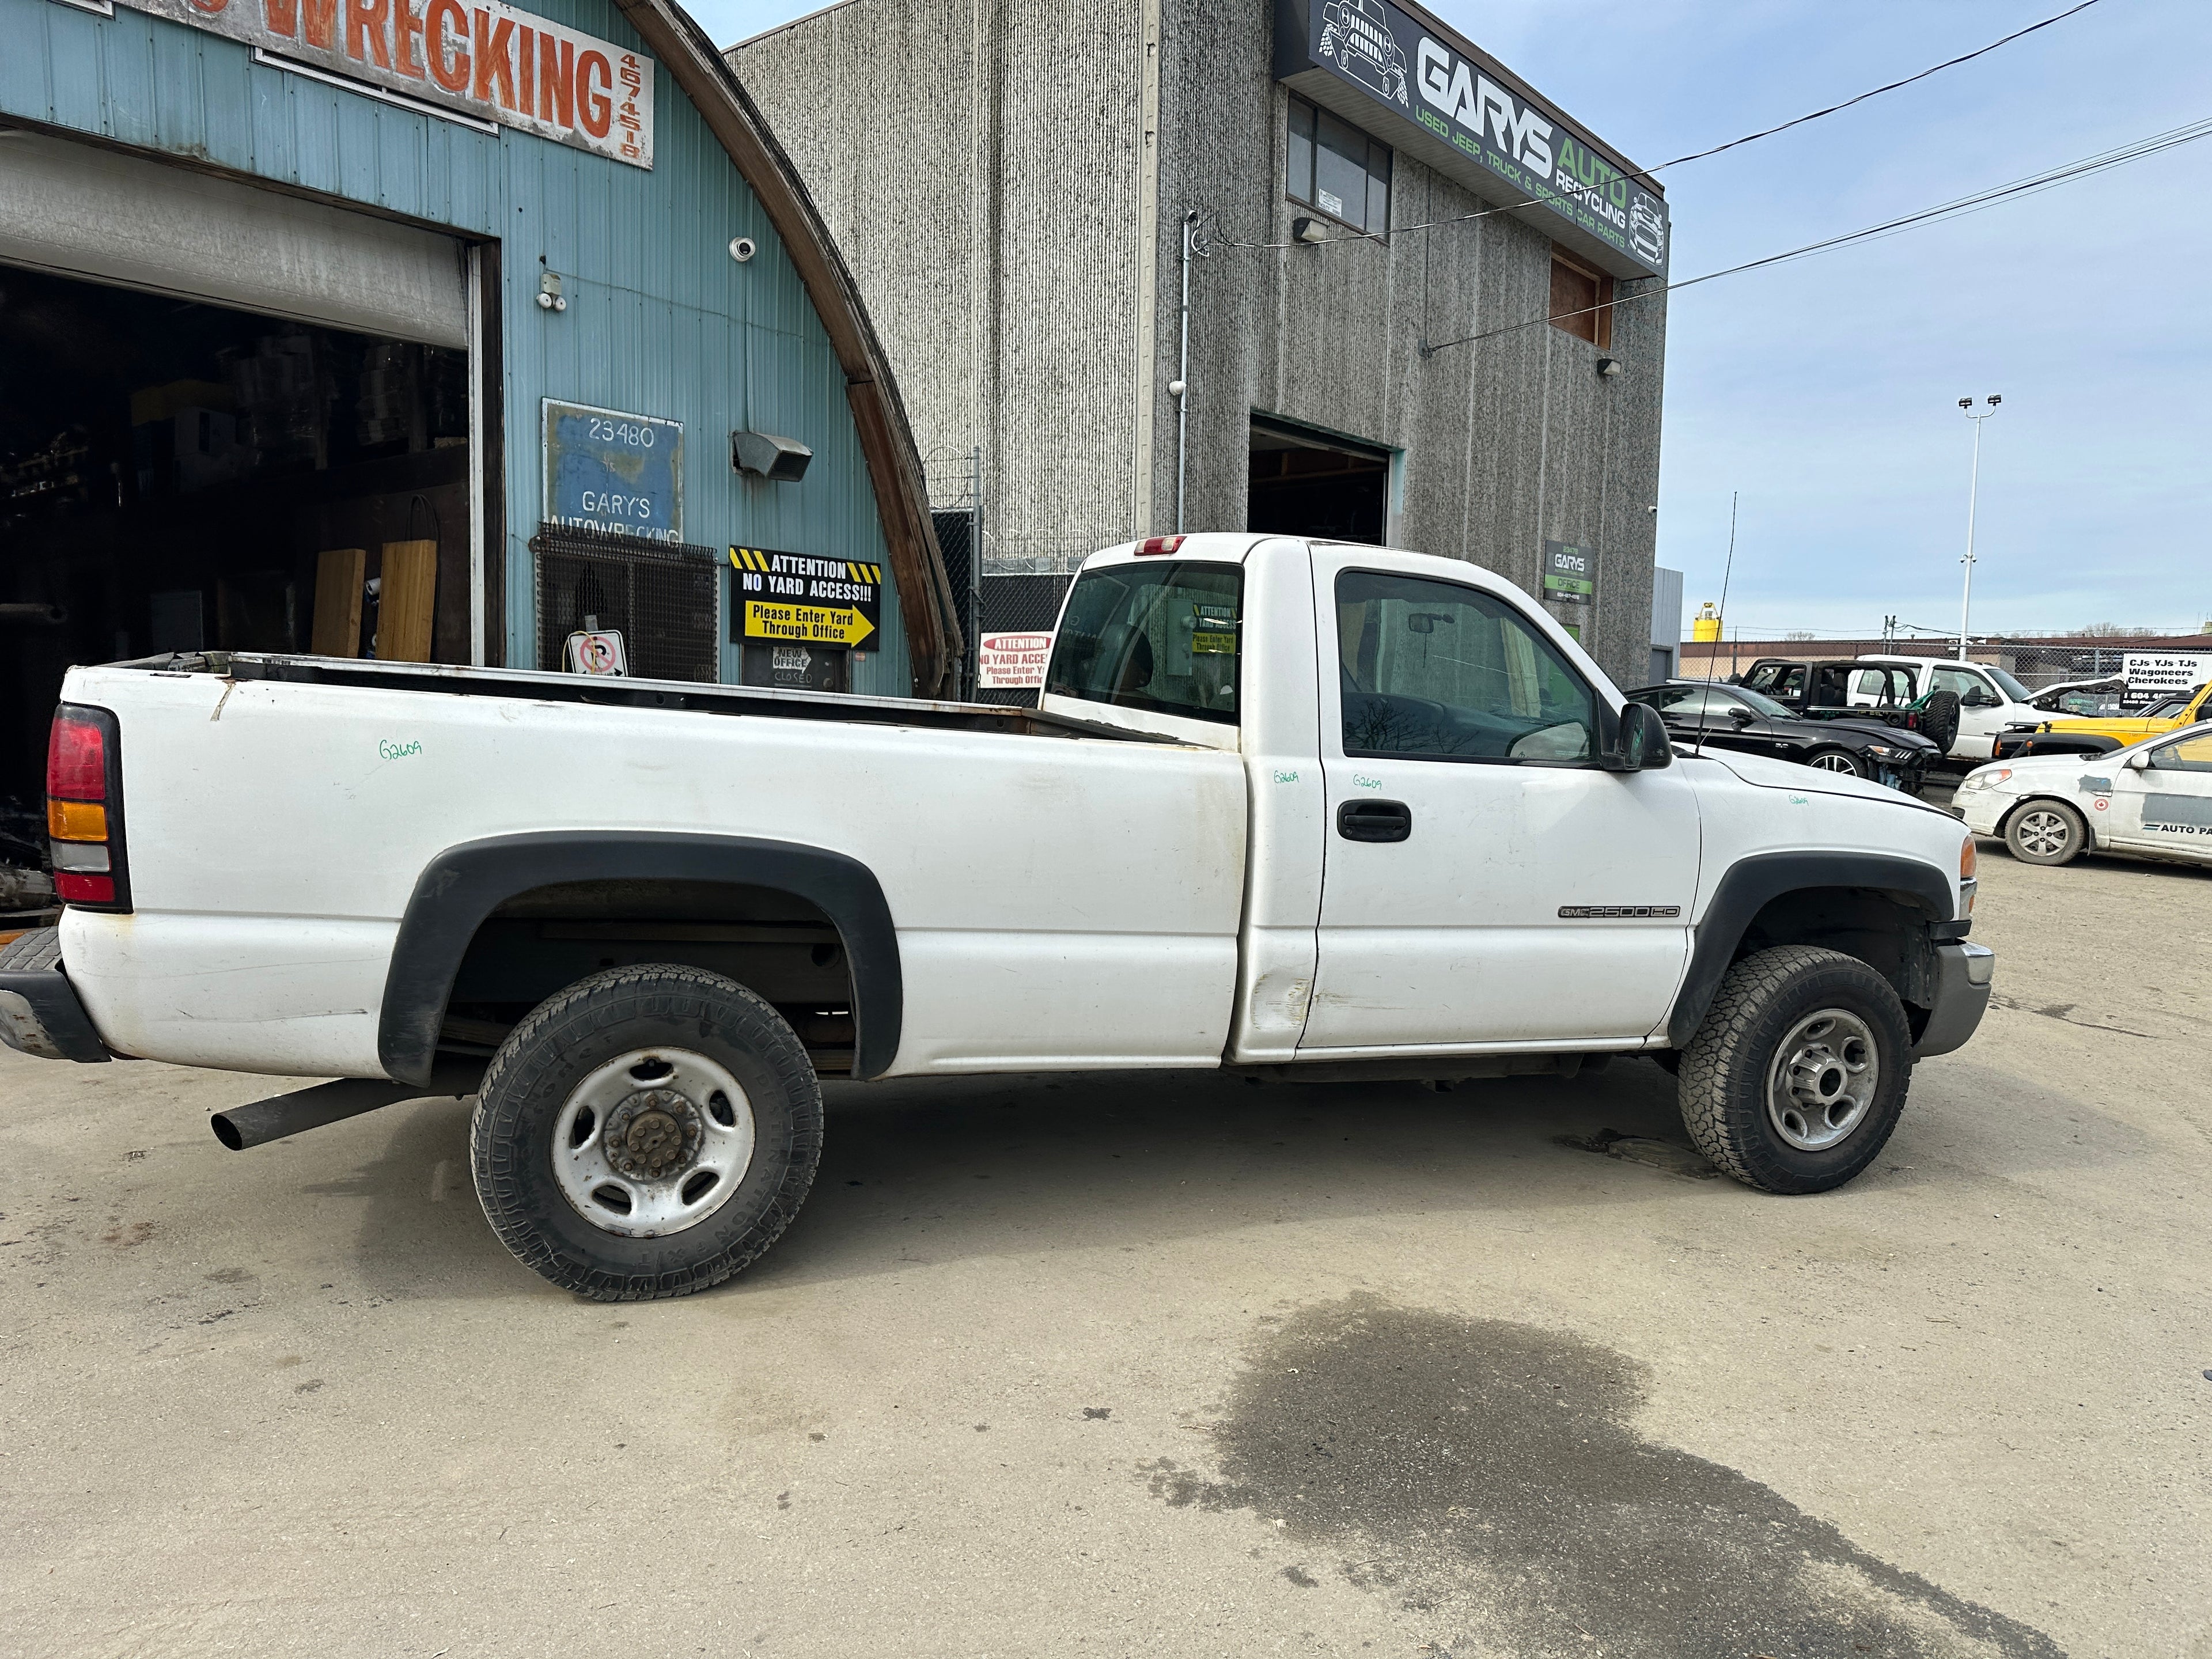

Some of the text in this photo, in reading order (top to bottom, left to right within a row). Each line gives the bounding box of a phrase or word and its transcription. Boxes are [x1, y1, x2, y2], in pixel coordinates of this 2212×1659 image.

[1417, 36, 1553, 179] GARYS
[1415, 104, 1625, 248] USED JEEP, TRUCK & SPORTS CAR PARTS
[1558, 137, 1627, 209] AUTO
[1556, 168, 1626, 229] RECYCLING
[589, 418, 654, 448] 23480
[582, 491, 650, 518] GARY'S
[771, 554, 846, 579] ATTENTION
[1555, 554, 1585, 572] GARYS
[743, 573, 872, 602] NO YARD ACCESS!!!
[1558, 578, 1581, 589] OFFICE
[753, 605, 853, 626] Please Enter Yard
[1200, 605, 1231, 618] ATTENTION
[762, 620, 845, 639] Through Office
[994, 638, 1047, 649] ATTENTION
[1193, 634, 1233, 643] Please Enter Yard
[779, 649, 802, 658] NEW
[980, 654, 1048, 665] NO YARD ACCE
[774, 656, 807, 668] OFFICE
[986, 666, 1011, 675] Please
[2129, 668, 2194, 676] Wagoneers
[774, 672, 812, 684] CLOSED
[992, 676, 1023, 685] Through
[2161, 824, 2195, 834] AUTO
